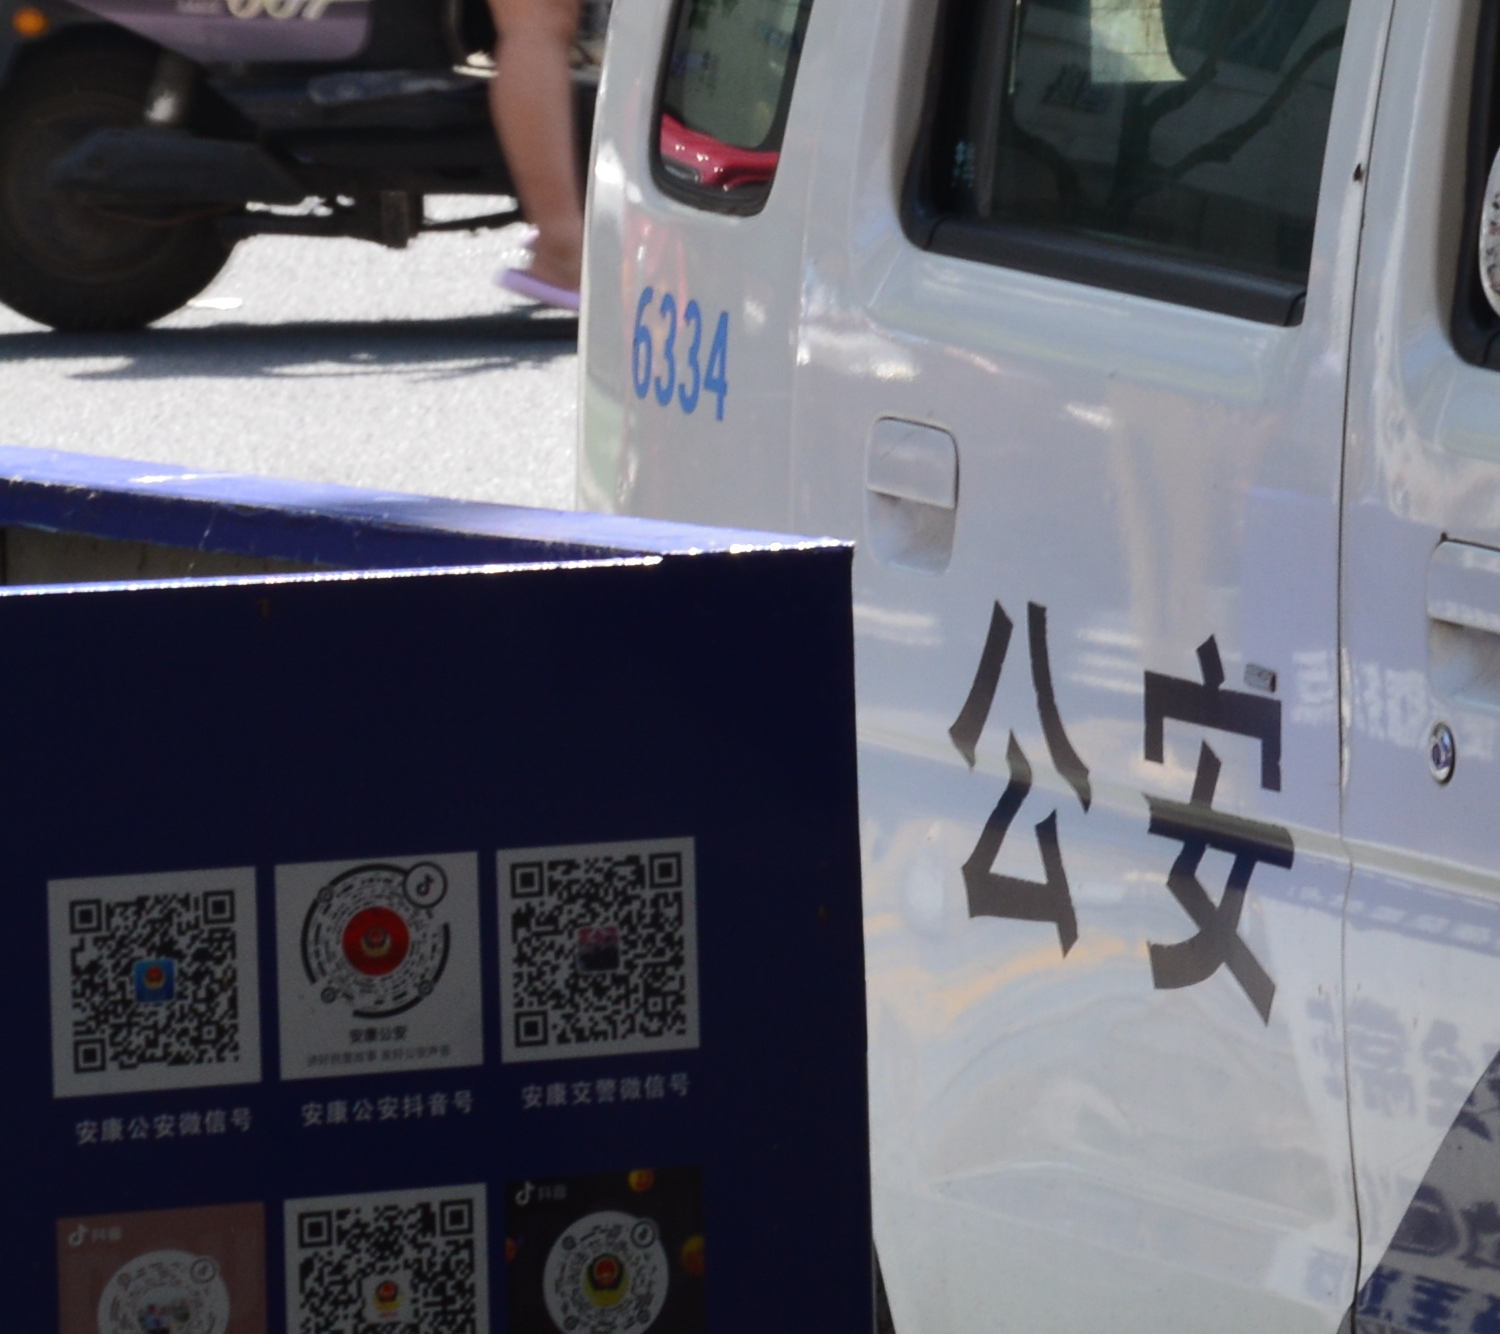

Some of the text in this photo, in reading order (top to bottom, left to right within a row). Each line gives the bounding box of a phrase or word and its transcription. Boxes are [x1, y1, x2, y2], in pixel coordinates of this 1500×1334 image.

[633, 286, 730, 422] 6334
[948, 599, 1296, 1026] 公安
[349, 1025, 408, 1043] 安康公安
[300, 1089, 475, 1127] 安康公安抖音号
[520, 1072, 691, 1110] 安康交警微信号
[75, 1105, 253, 1146] 安康公安微信号
